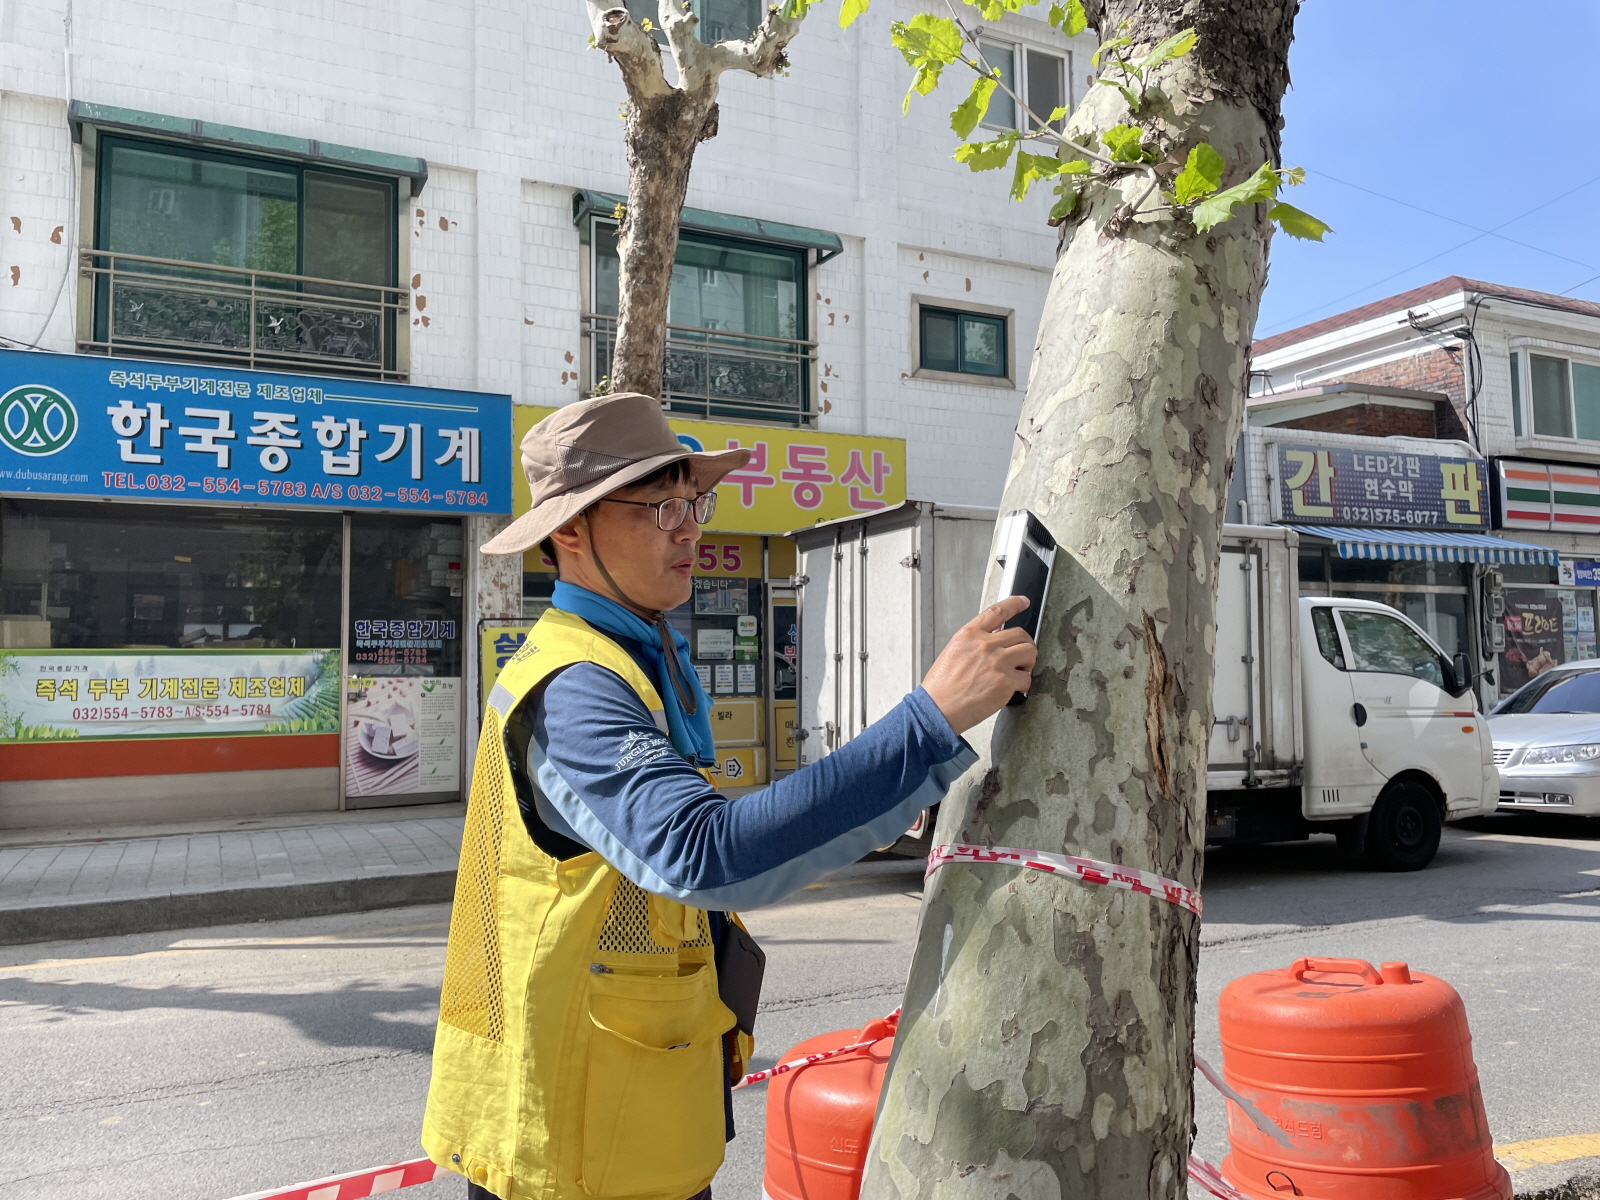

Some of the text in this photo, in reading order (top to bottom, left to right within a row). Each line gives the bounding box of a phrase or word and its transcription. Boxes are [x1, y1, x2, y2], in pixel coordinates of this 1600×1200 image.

[109, 370, 323, 404] 즉석두부기계전문 제조업체
[106, 400, 481, 483] 한국종합기계
[719, 438, 892, 510] 부동산
[1353, 454, 1421, 478] LED간판
[102, 472, 488, 506] TEL.032-554-5783 A/S 032-554-5784
[1285, 450, 1483, 525] 간 판
[1364, 478, 1414, 502] 현수막
[1342, 506, 1438, 525] 032)575-6077
[355, 619, 456, 640] 한국종합기계
[36, 675, 306, 702] 즉석 두부 기계전문 제조업체
[614, 741, 650, 772] JUNGLE
